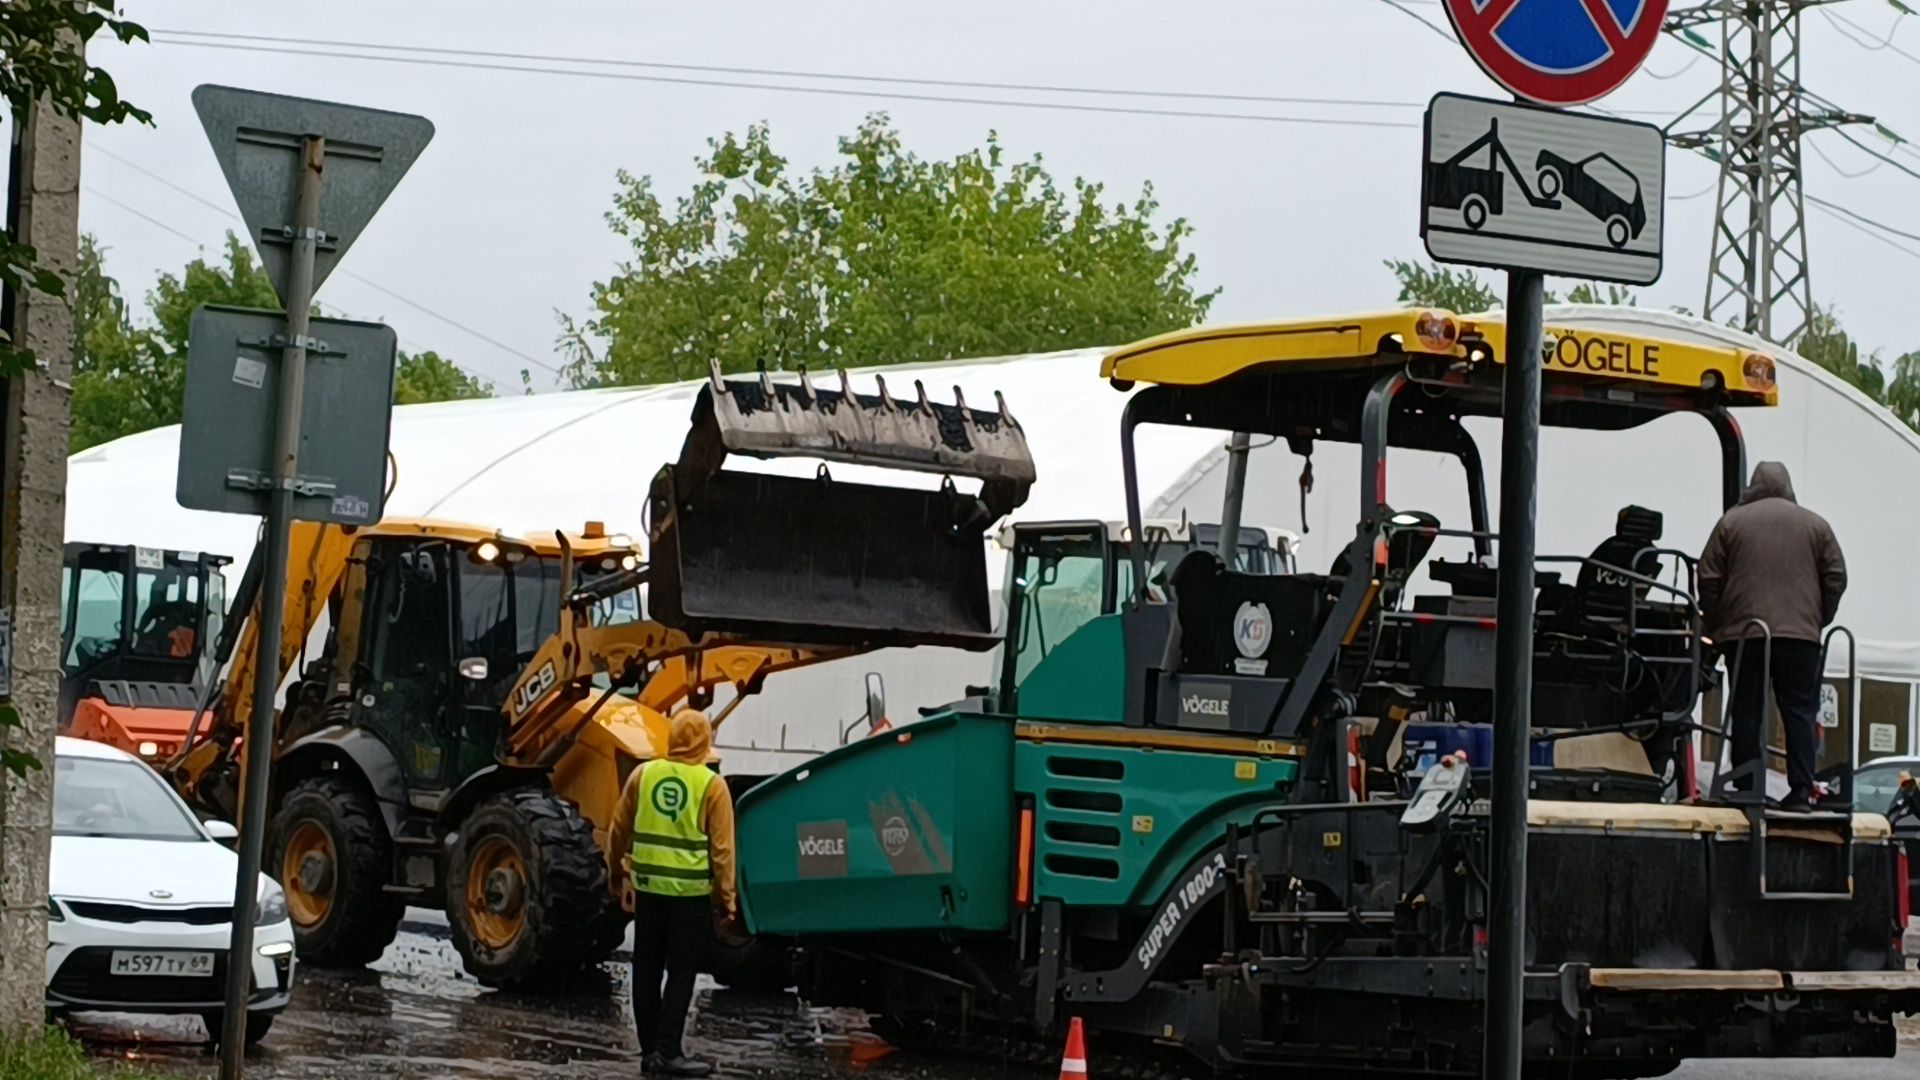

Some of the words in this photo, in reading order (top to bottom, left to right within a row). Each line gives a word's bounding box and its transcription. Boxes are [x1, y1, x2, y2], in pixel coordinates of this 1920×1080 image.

[516, 662, 555, 713] JCB
[1182, 694, 1229, 715] VÖGELE
[798, 835, 845, 856] VÖGELE
[1138, 902, 1181, 970] SUPER
[190, 956, 209, 968] 69
